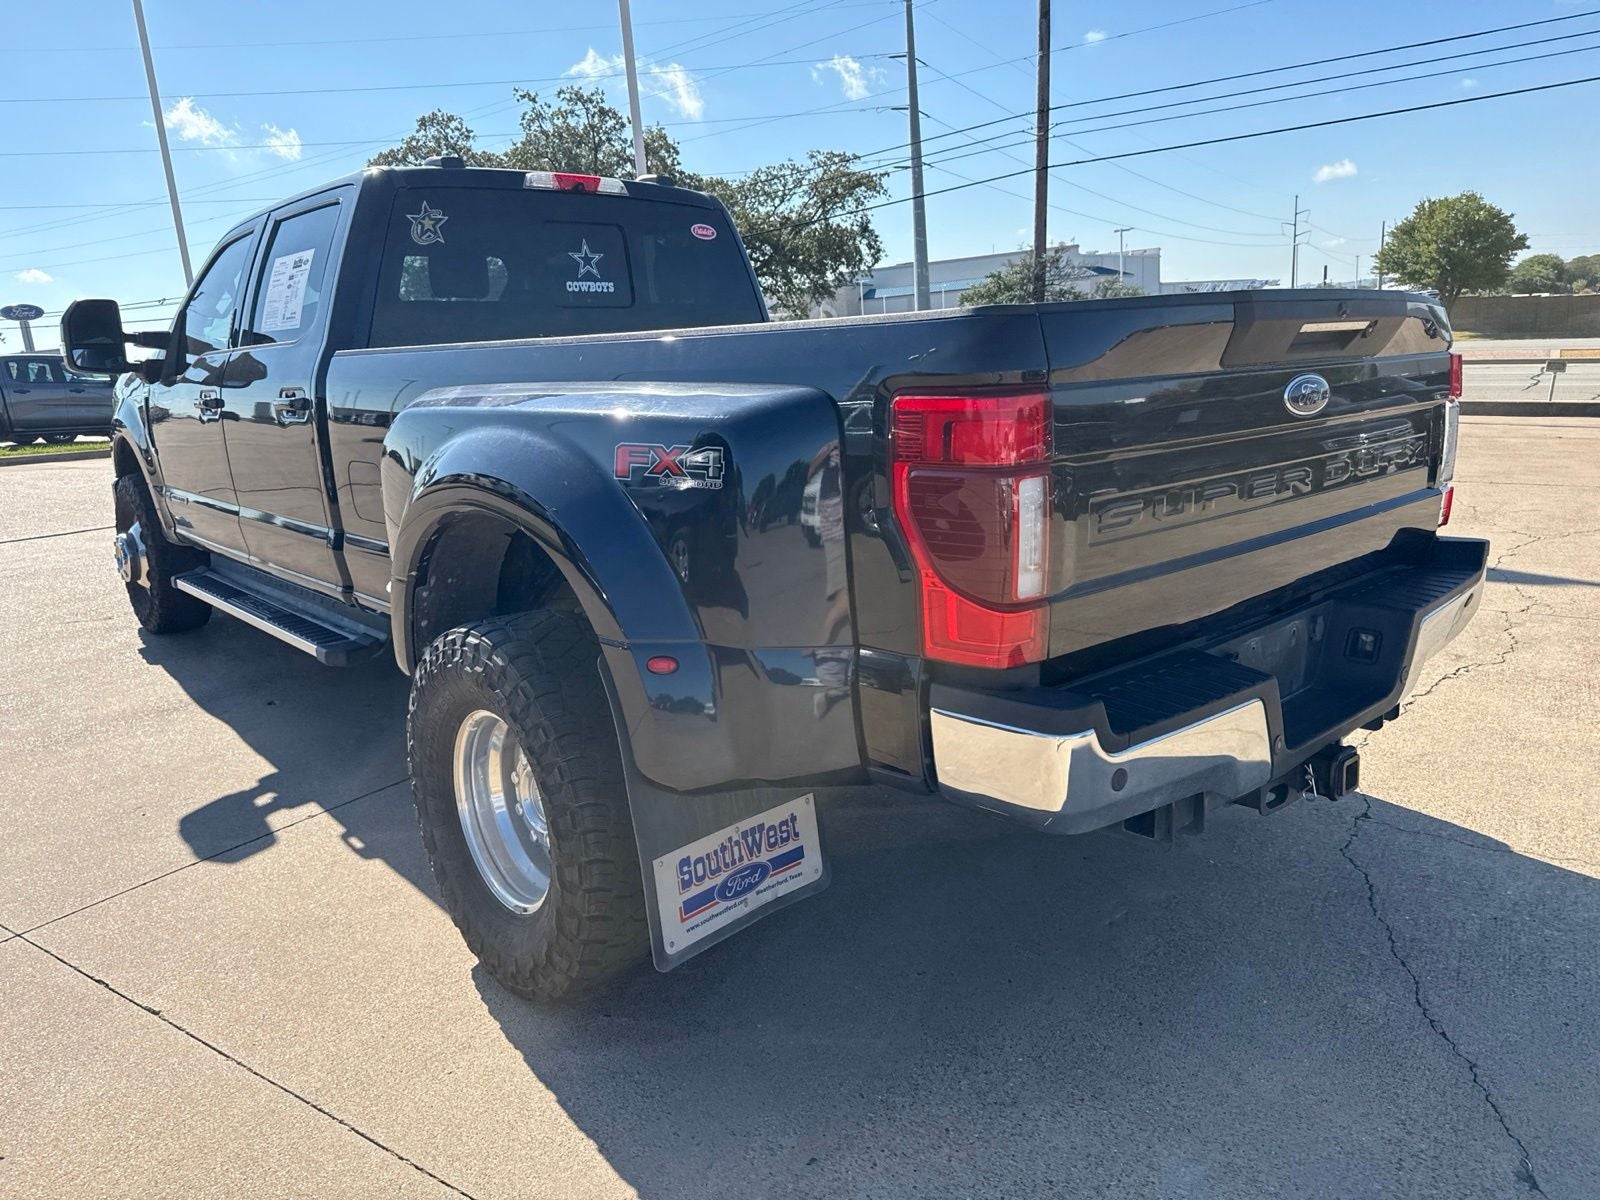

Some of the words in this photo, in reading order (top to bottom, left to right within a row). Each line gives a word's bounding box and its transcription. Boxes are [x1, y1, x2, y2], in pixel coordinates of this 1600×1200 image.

[566, 281, 615, 293] COWBOYS
[10, 307, 36, 318] Ford
[1298, 383, 1322, 406] Ford
[614, 442, 725, 481] FX4
[1098, 467, 1313, 534] SUPER
[1323, 441, 1427, 487] DUTY
[677, 812, 800, 895] SouthWest
[725, 868, 761, 897] Ford
[788, 871, 803, 881] Texas
